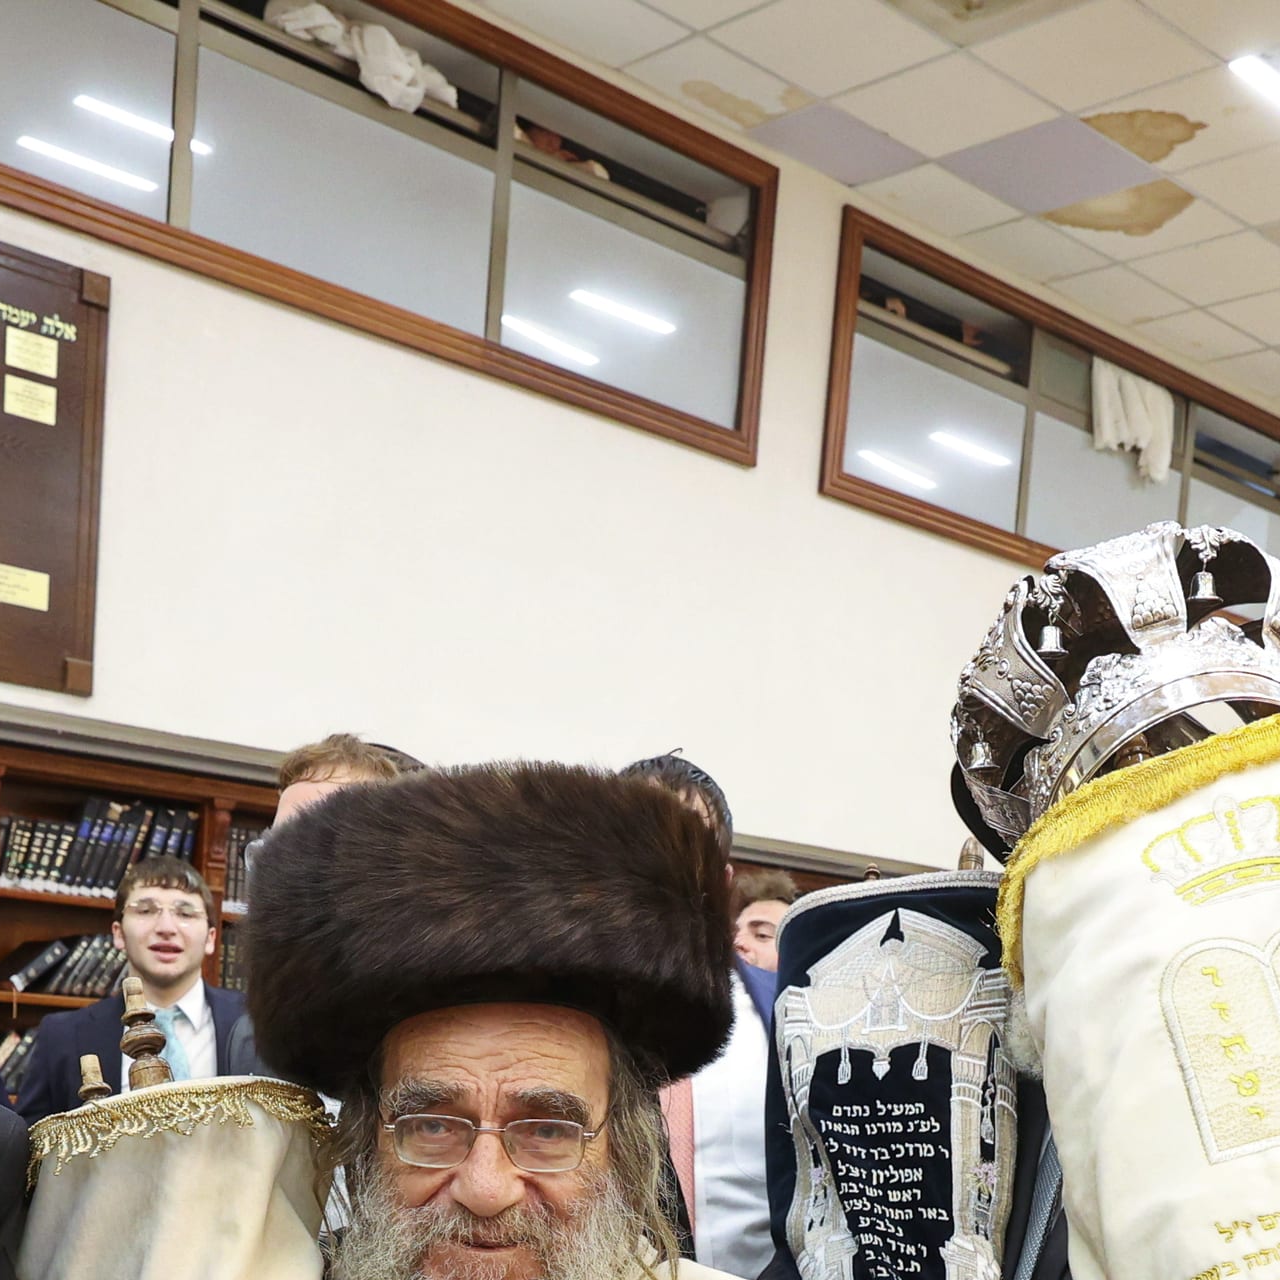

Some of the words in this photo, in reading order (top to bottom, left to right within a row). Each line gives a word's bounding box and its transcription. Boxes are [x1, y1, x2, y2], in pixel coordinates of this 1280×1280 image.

[40, 313, 77, 342] אלה
[876, 1099, 925, 1116] המעיל
[820, 1119, 860, 1136] הגאון
[864, 1121, 903, 1136] מורנו
[842, 1142, 867, 1159] דוד
[890, 1142, 935, 1158] מרדכי
[839, 1182, 883, 1197] ישיבת
[887, 1188, 921, 1202] ראש
[873, 1202, 913, 1220] התורה
[918, 1207, 950, 1221] באר
